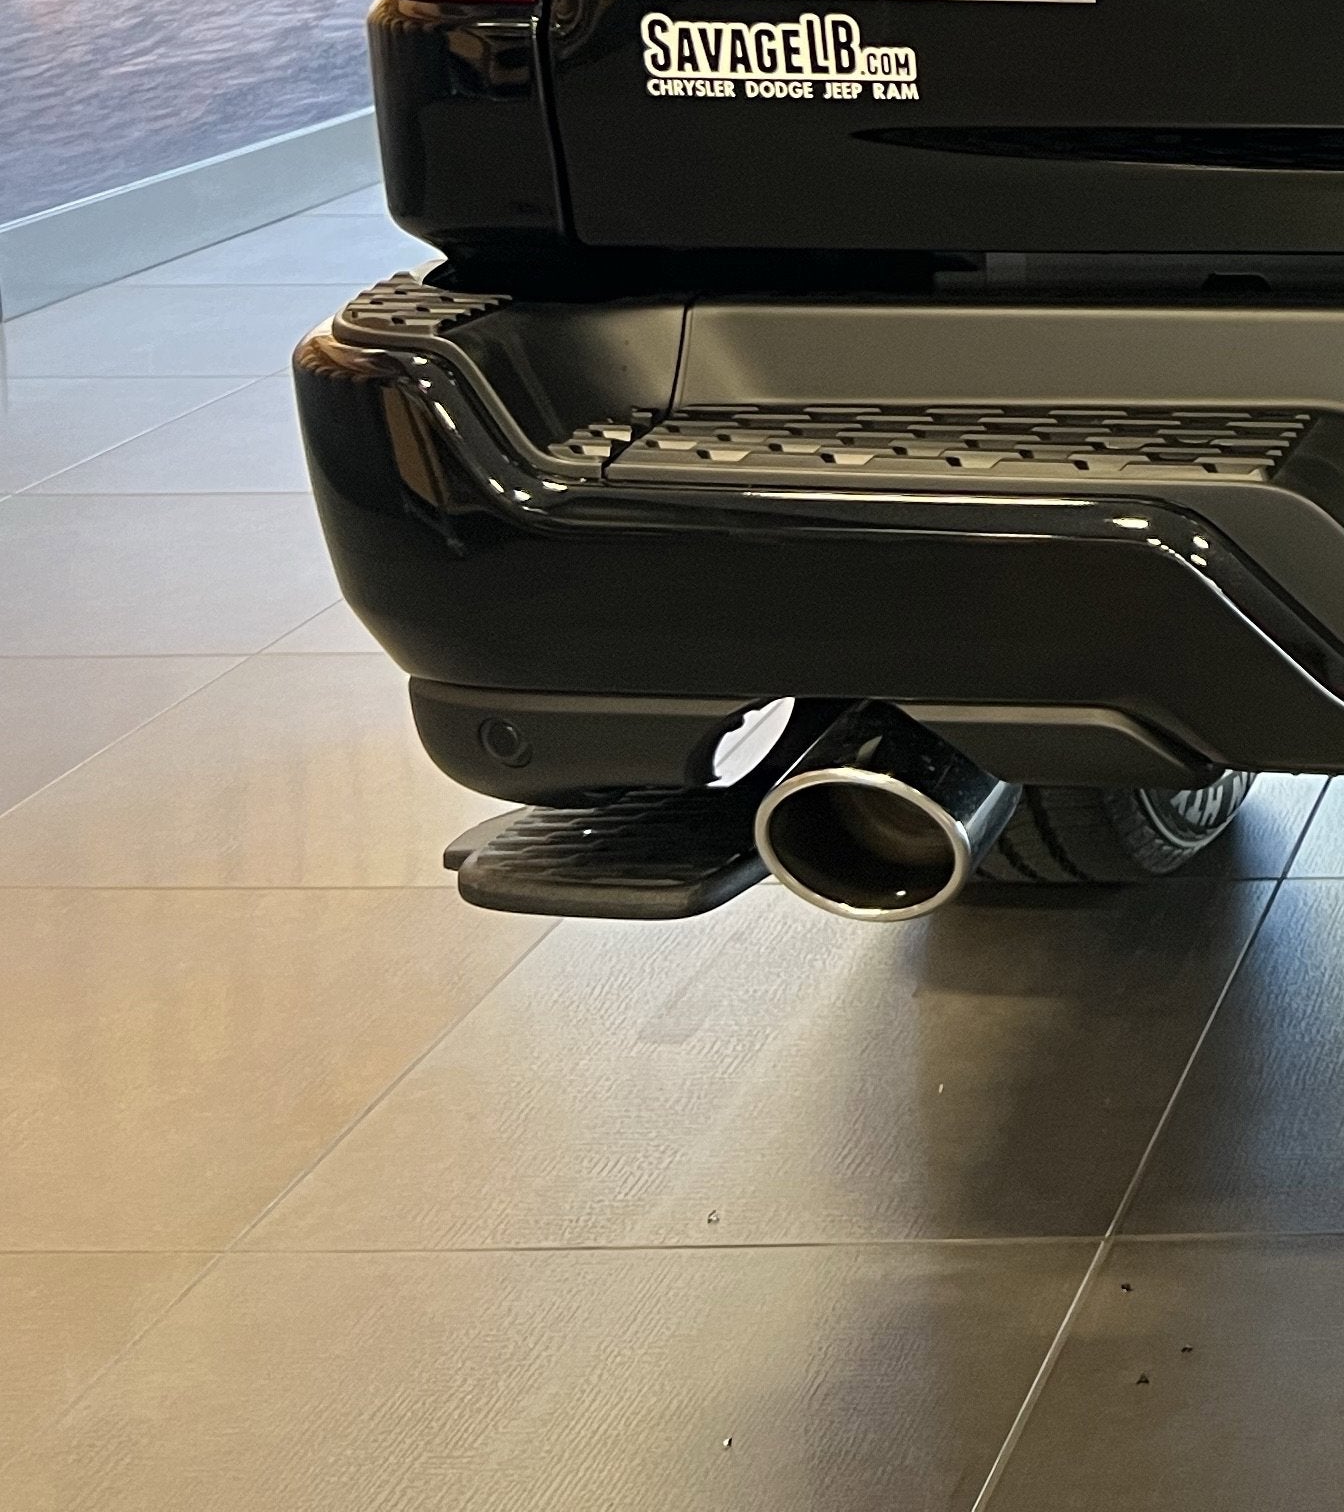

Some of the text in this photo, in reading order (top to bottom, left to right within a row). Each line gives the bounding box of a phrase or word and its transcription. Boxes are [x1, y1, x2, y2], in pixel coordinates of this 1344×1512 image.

[646, 78, 920, 100] CHRYSLER DODGE JEEP RAM
